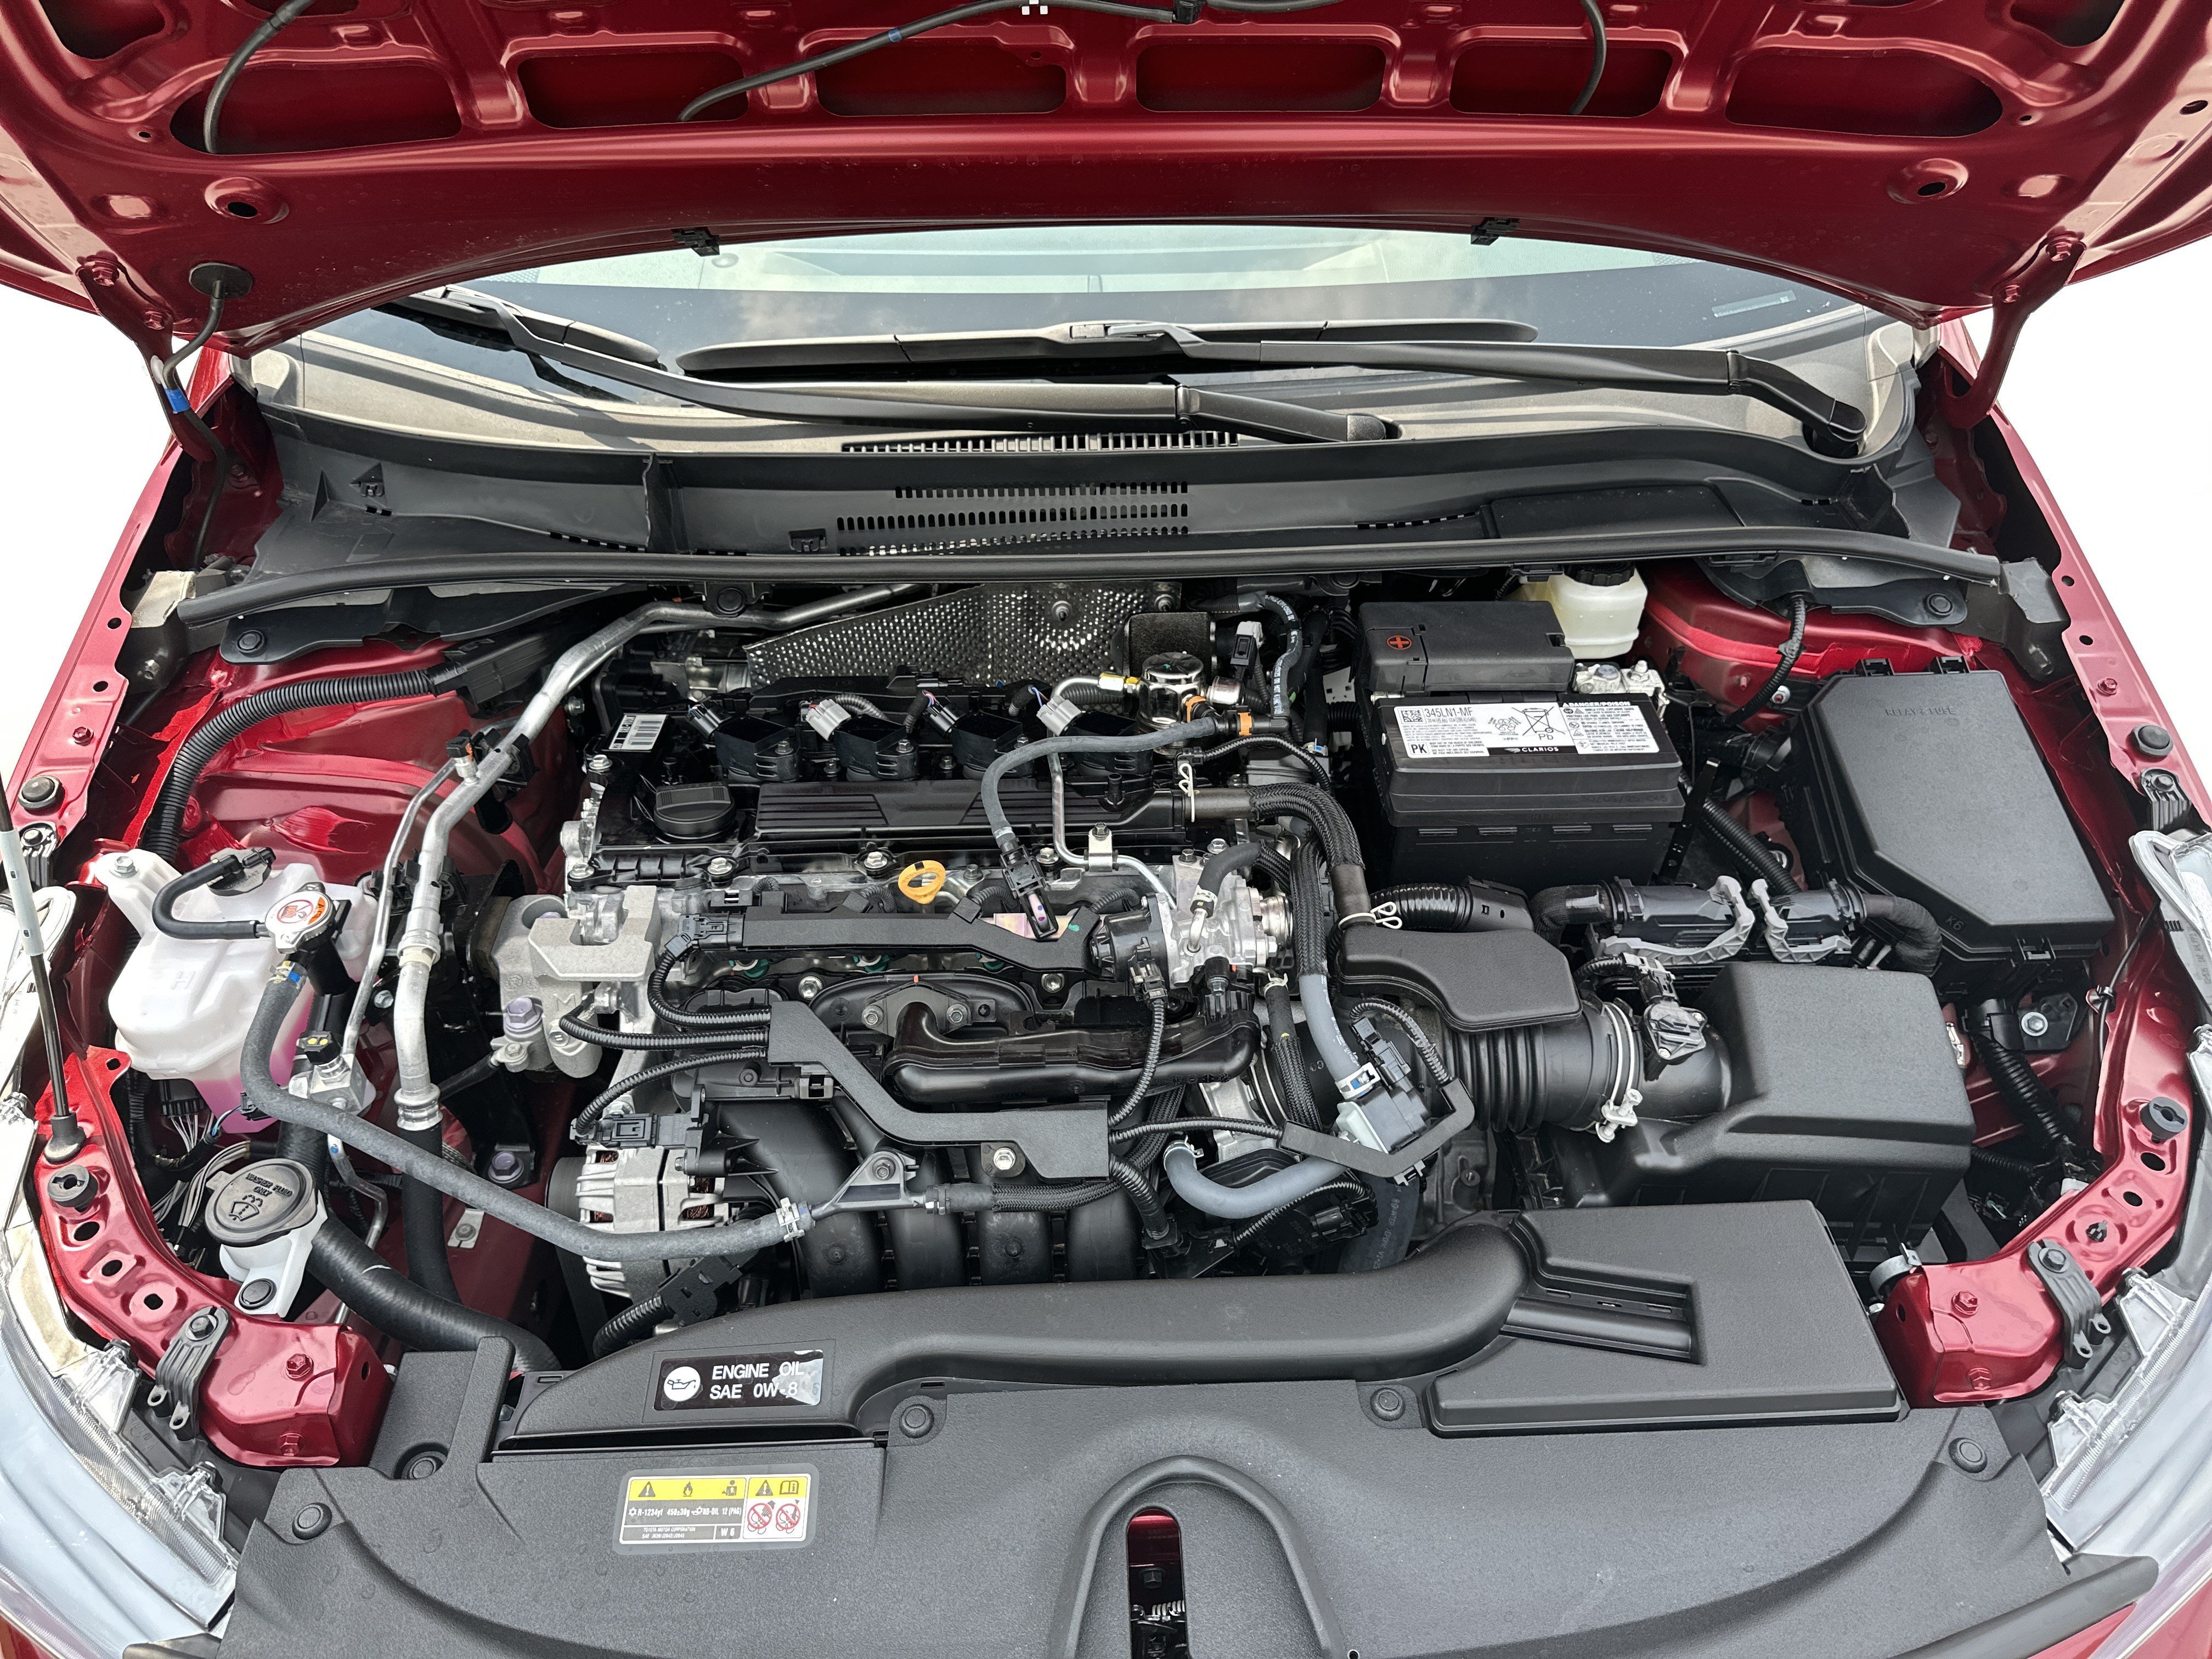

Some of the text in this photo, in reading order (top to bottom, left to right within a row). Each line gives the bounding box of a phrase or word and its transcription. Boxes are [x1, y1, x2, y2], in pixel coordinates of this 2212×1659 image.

[1424, 707, 1473, 718] 345LN1-MF
[1410, 743, 1427, 754] PK
[253, 1186, 272, 1197] ONLY
[272, 1184, 292, 1197] FLUID
[712, 1361, 804, 1380] ENGINE OIL
[709, 1381, 798, 1399] SAE 0W-8
[729, 1507, 742, 1516] (PAG)
[721, 1528, 735, 1536] W 6
